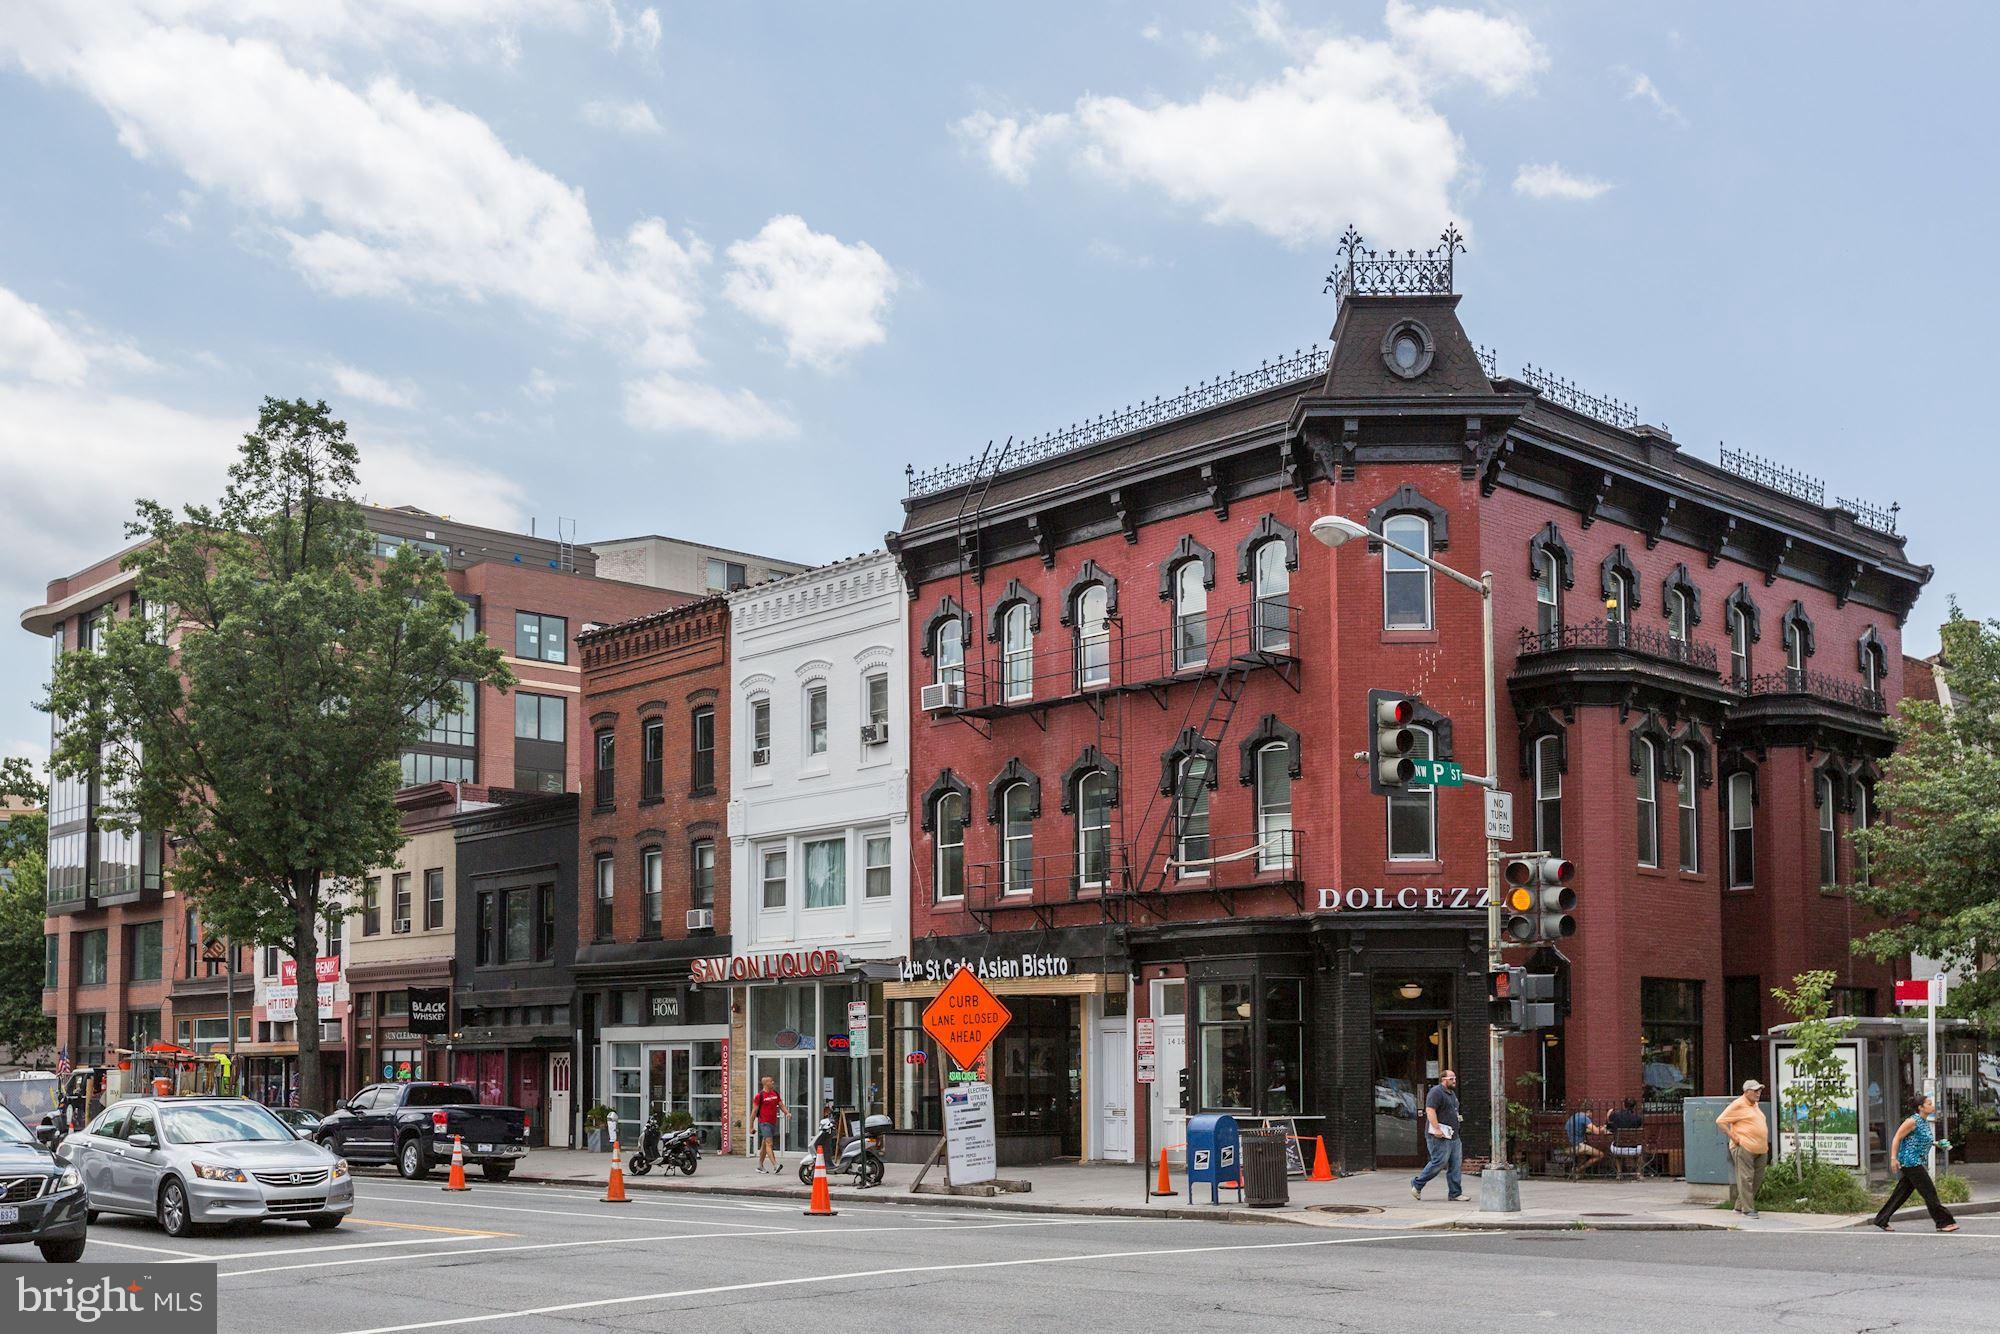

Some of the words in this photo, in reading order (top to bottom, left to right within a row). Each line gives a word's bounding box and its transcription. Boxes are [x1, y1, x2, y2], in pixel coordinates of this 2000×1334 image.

[1414, 765, 1427, 778] NW
[1432, 763, 1445, 783] P
[1451, 768, 1462, 781] ST
[1493, 799, 1504, 809] NO
[1490, 810, 1508, 821] TURN
[1488, 822, 1497, 832] ON
[1499, 823, 1511, 834] RED
[1317, 886, 1507, 909] DOLCEZZ
[691, 956, 728, 984] SAV
[732, 955, 762, 981] ON
[765, 949, 842, 979] LIQUOR
[899, 960, 923, 982] 14th
[978, 956, 1019, 979] Asian
[1022, 953, 1068, 977] Bistro
[411, 1001, 446, 1013] BLACK
[949, 995, 979, 1008] CURB
[412, 1012, 446, 1021] WHISKEY
[931, 1014, 956, 1027] LANE
[963, 1012, 999, 1025] CLOSED
[950, 1030, 982, 1043] AHEAD
[828, 1038, 849, 1048] OPEN
[967, 1086, 990, 1095] ELECTRIC
[970, 1093, 988, 1101] UTILITY
